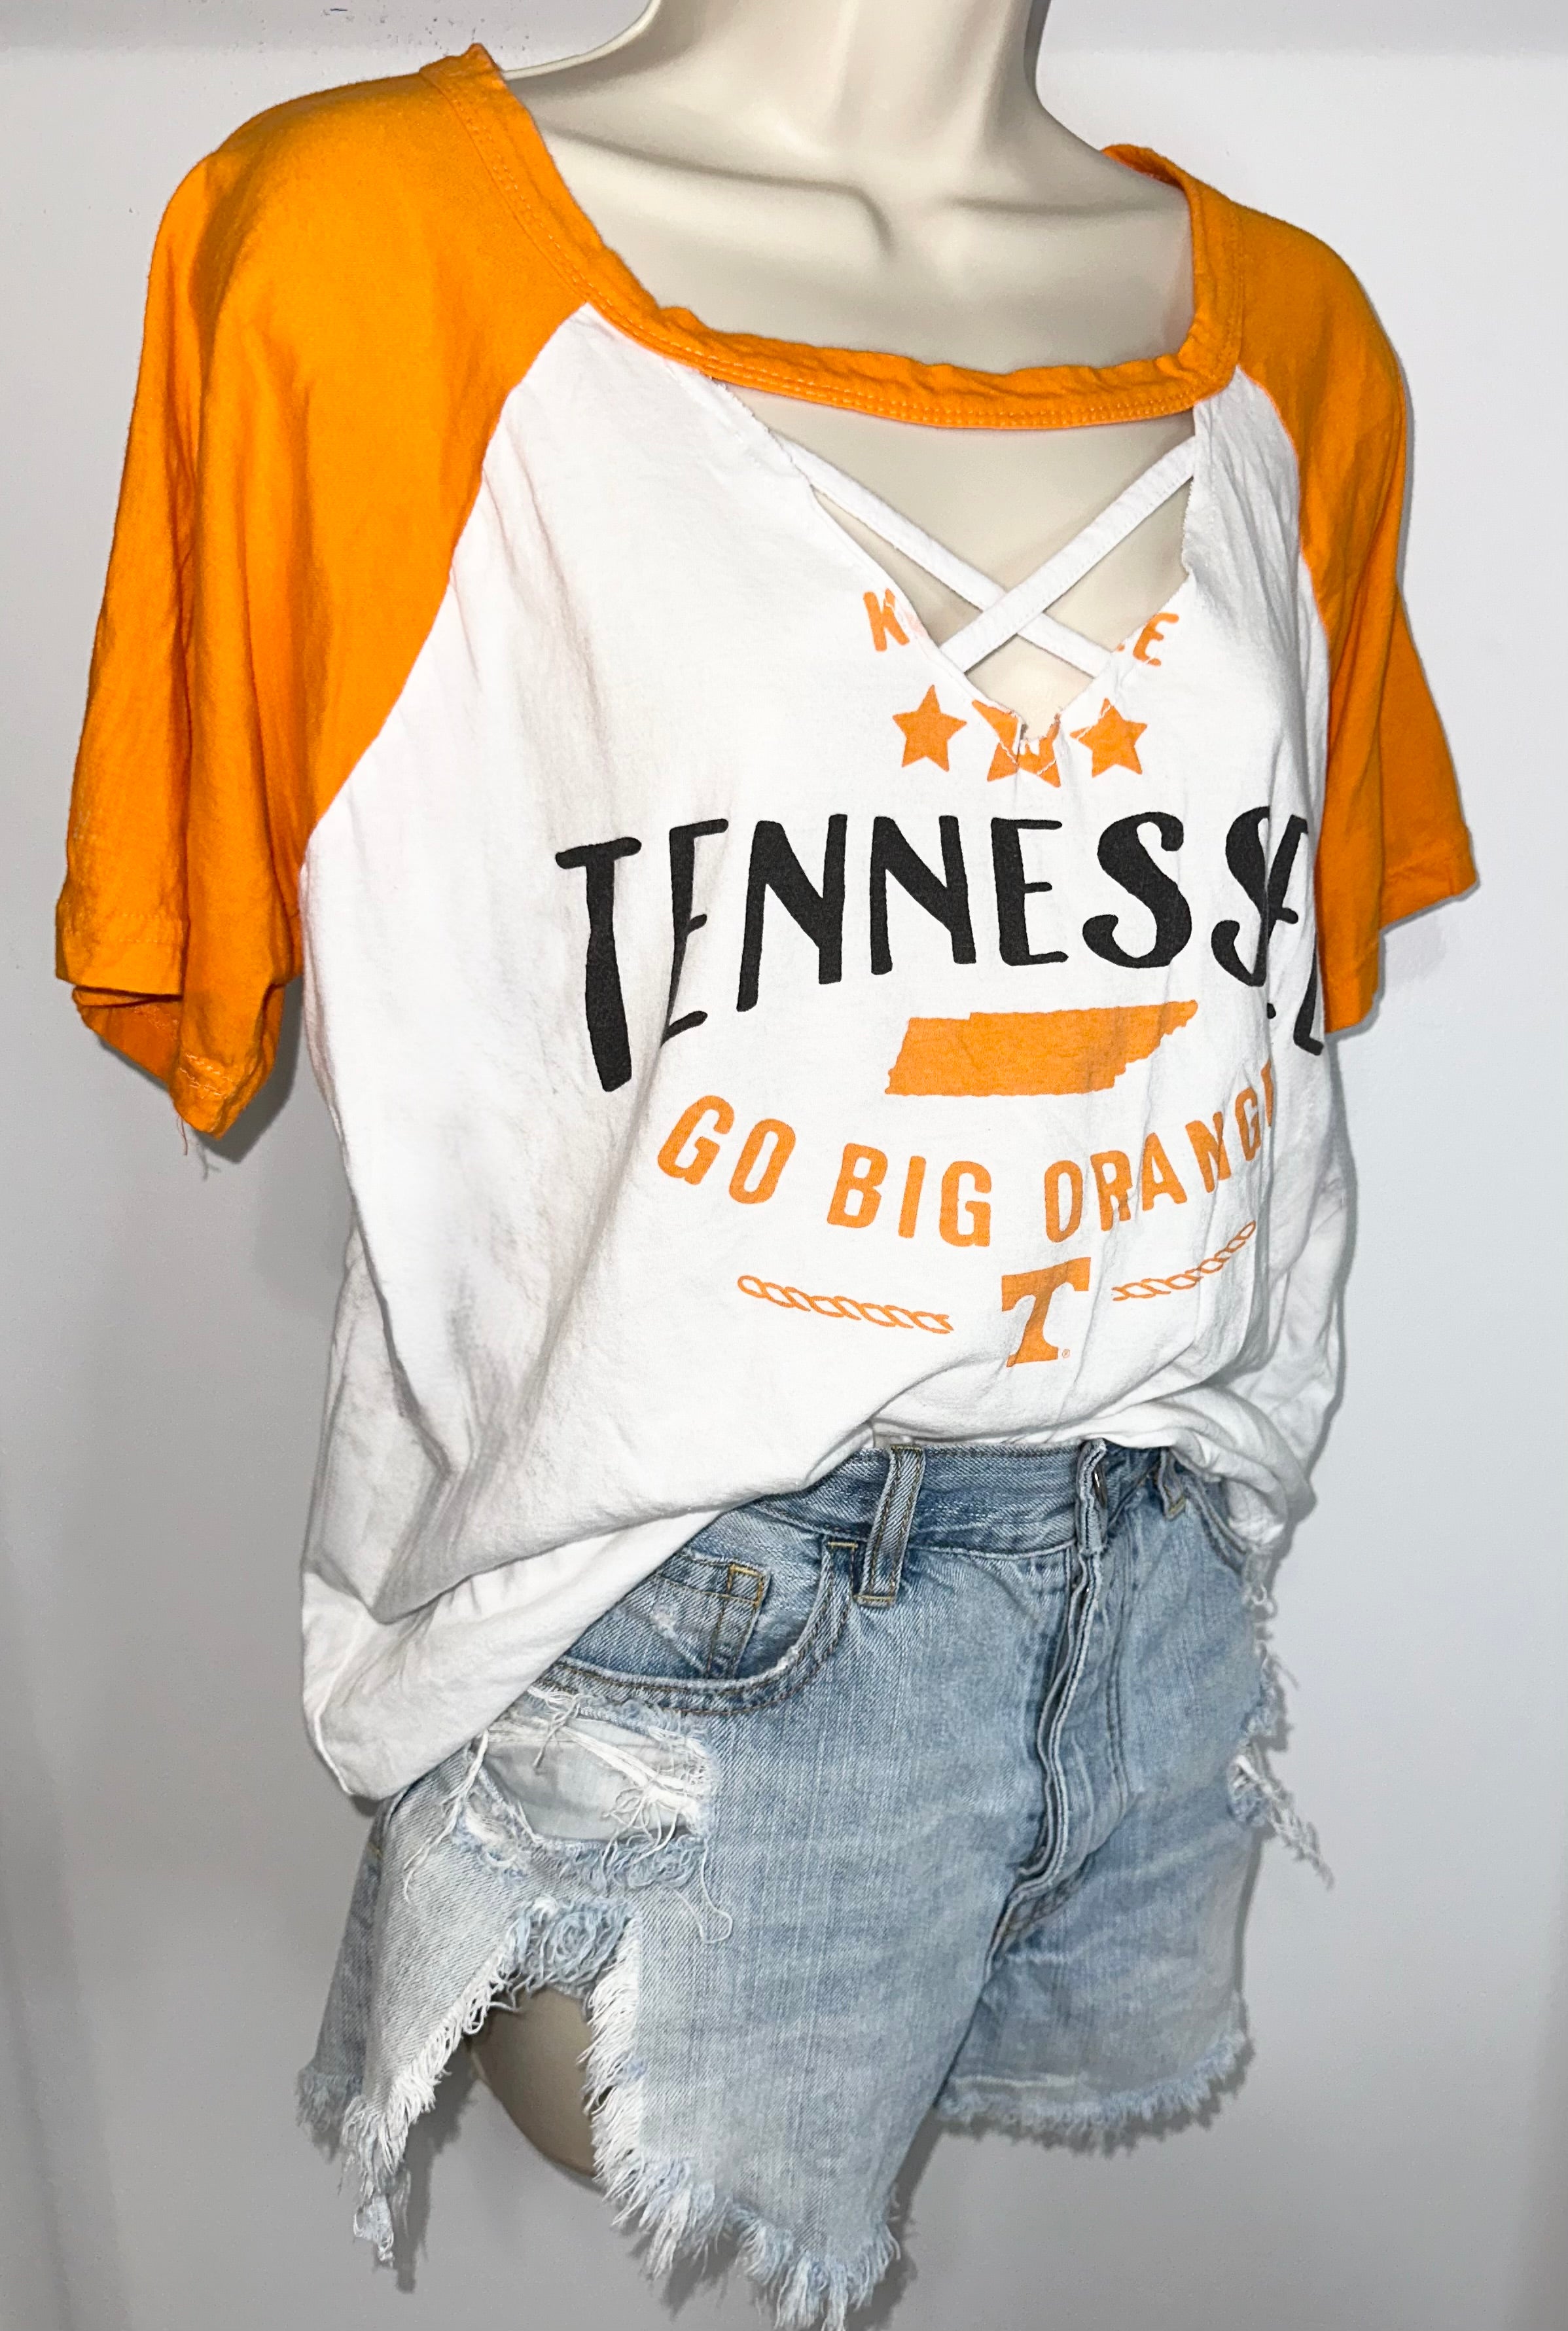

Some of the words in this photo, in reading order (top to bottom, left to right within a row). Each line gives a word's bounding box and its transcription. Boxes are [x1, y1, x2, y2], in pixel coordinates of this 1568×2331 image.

[657, 1095, 796, 1204] GO
[827, 1143, 992, 1247] BIG
[1001, 1257, 1091, 1367] T
